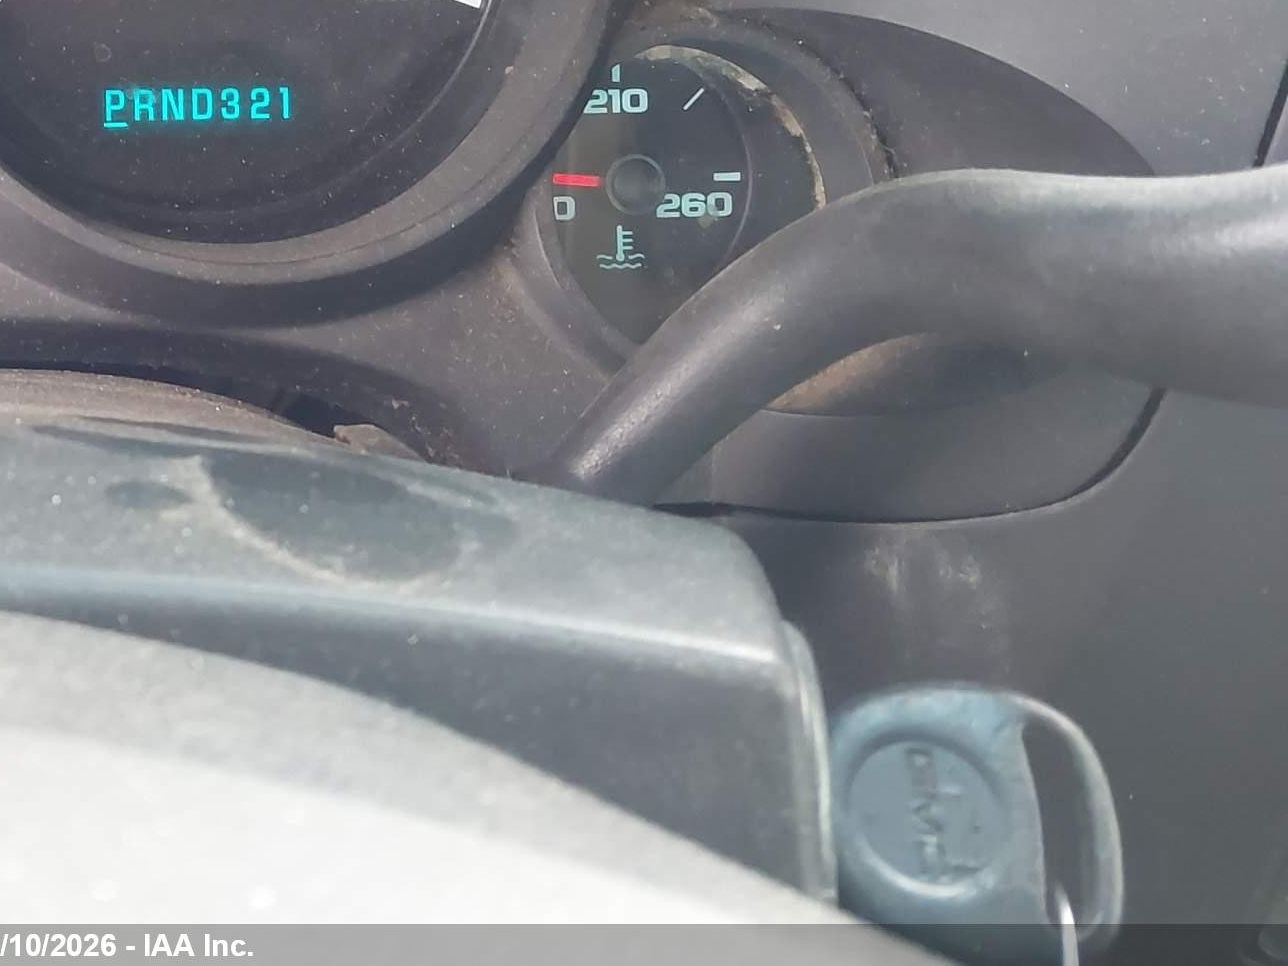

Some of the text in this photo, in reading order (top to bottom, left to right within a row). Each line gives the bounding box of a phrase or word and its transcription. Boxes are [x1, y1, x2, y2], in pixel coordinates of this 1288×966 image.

[102, 87, 290, 128] PRND321
[583, 88, 649, 115] 210
[656, 191, 734, 219] 260
